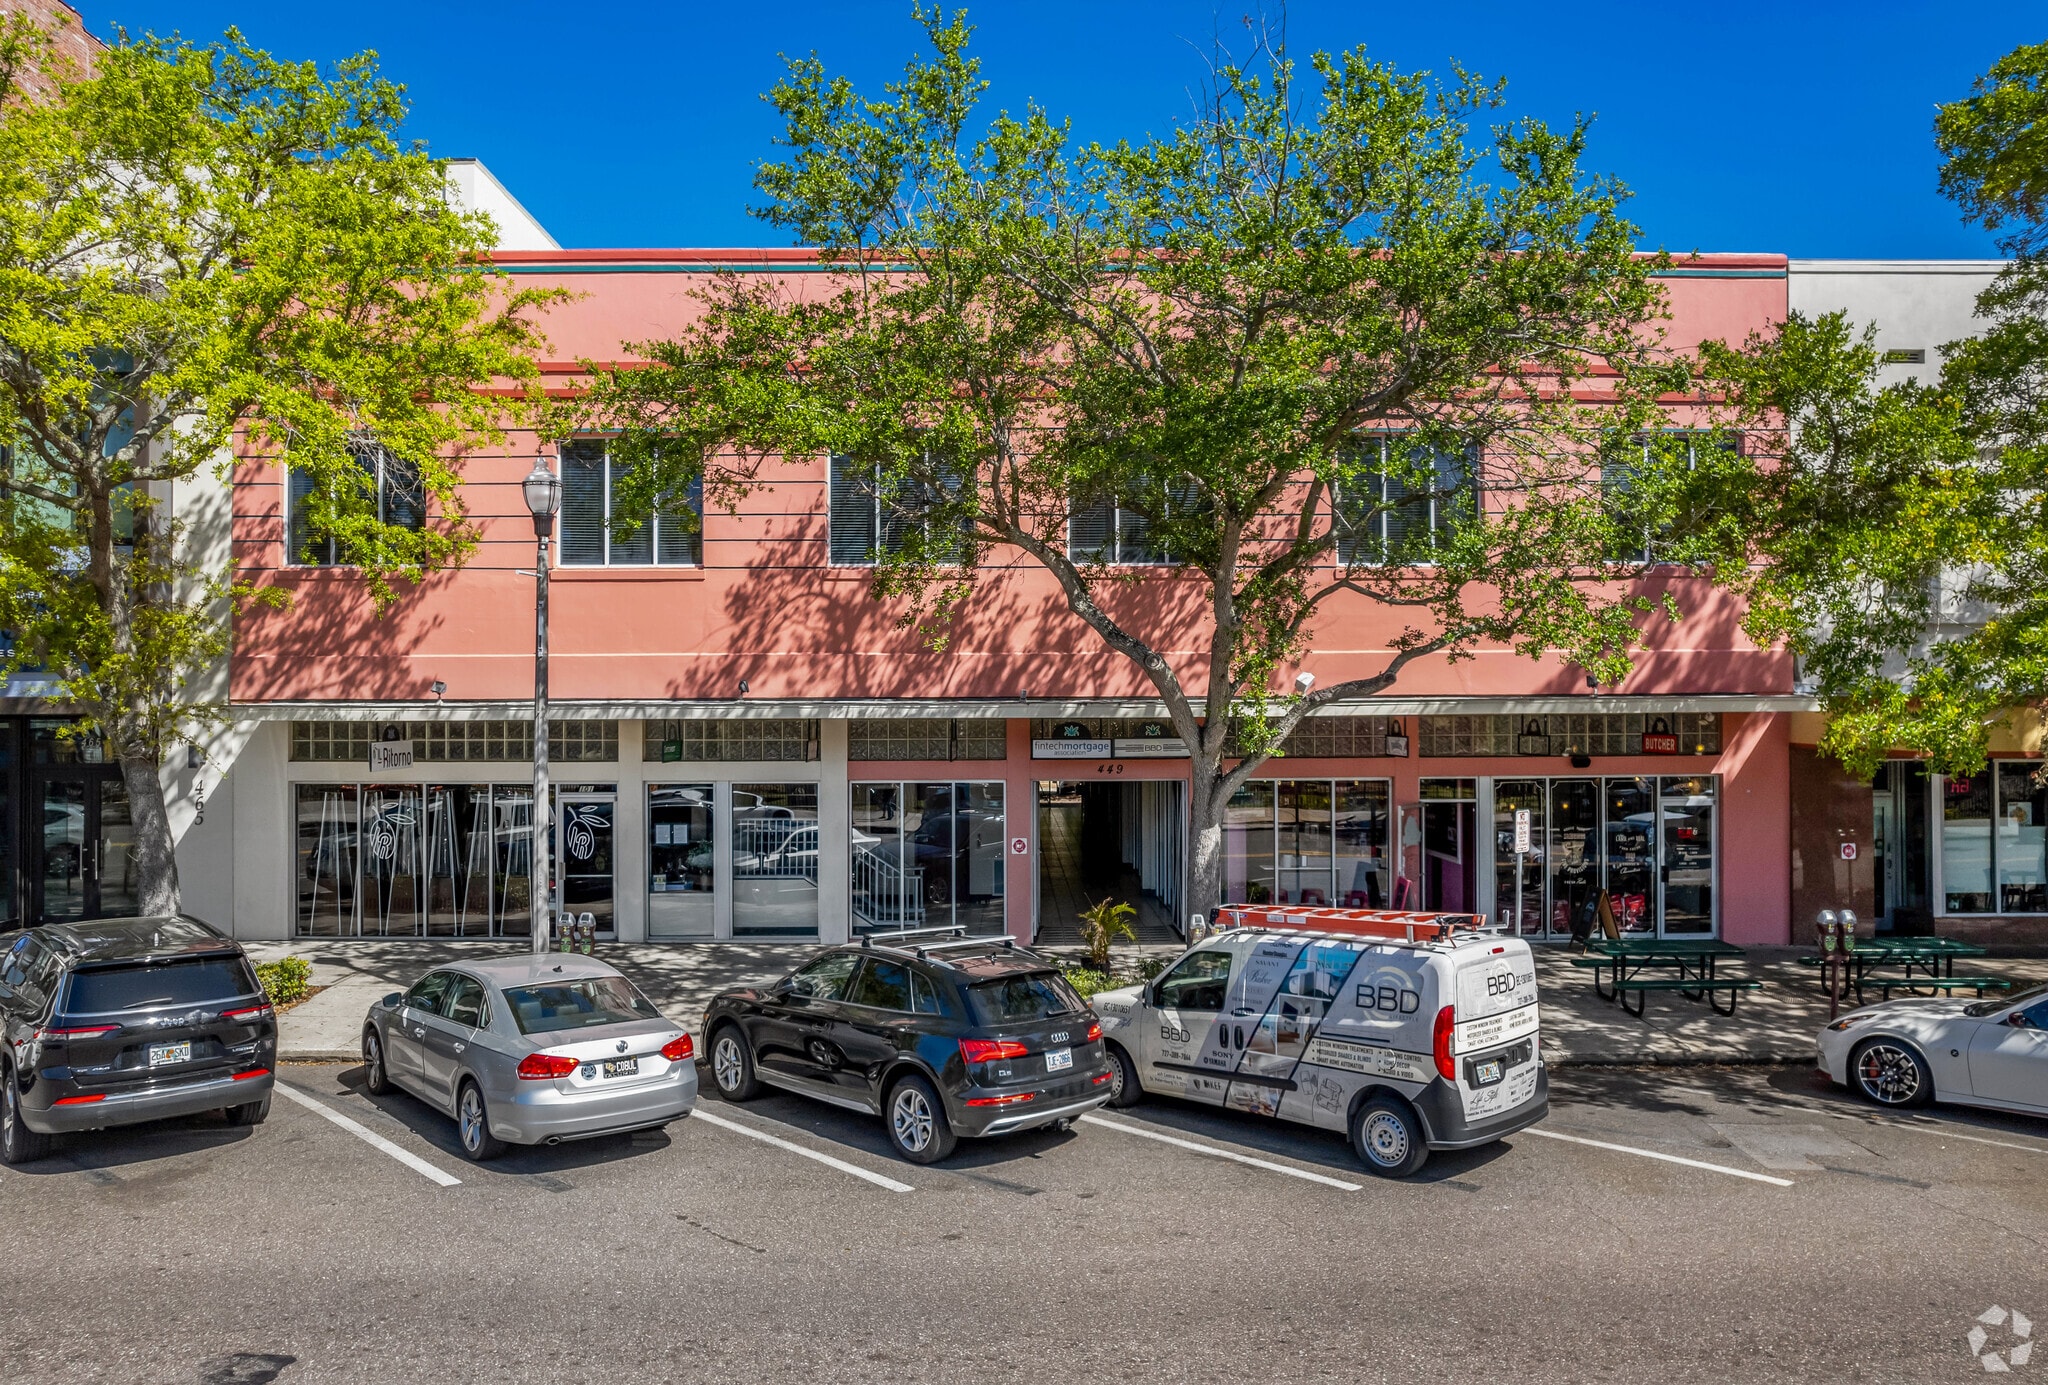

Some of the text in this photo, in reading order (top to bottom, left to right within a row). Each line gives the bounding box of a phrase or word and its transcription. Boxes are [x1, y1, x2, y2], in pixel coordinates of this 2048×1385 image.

[1034, 741, 1109, 753] fintechmortgage
[1144, 744, 1162, 752] BBD
[1645, 738, 1675, 750] BUTCHER
[383, 747, 412, 768] Ritorno
[1097, 764, 1124, 775] 449
[1487, 972, 1516, 997] BBD
[1355, 984, 1420, 1015] BBD
[1160, 1026, 1191, 1043] BBD
[1212, 1050, 1234, 1060] SONY
